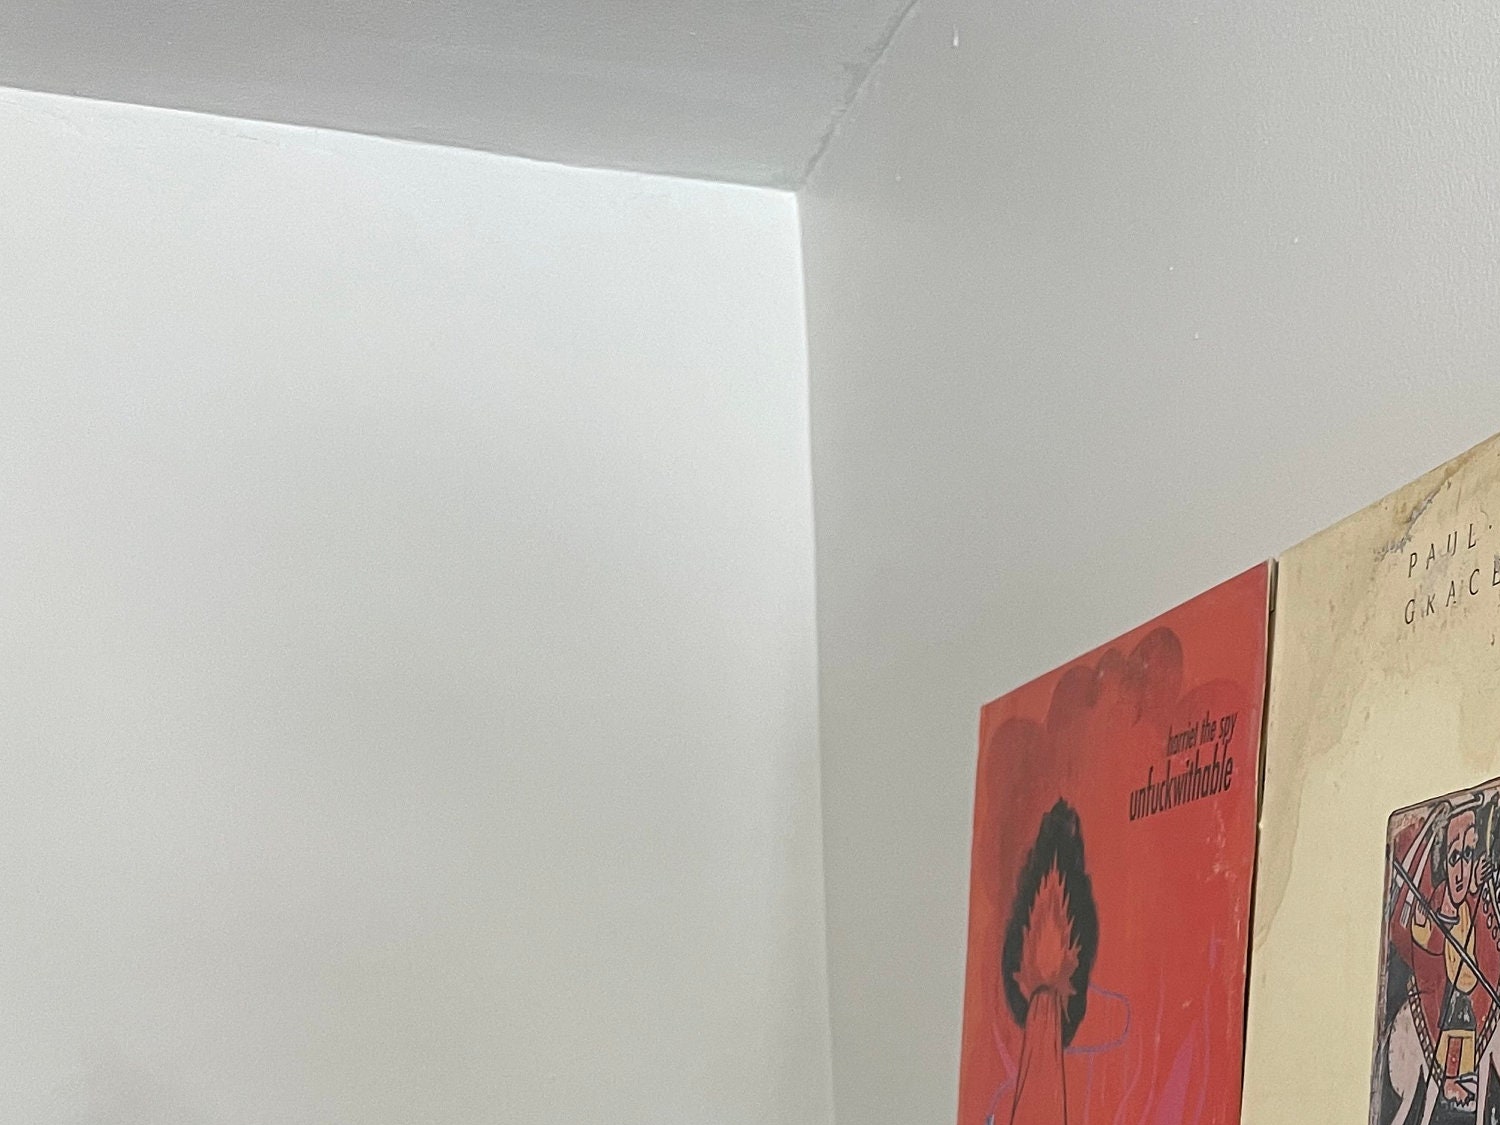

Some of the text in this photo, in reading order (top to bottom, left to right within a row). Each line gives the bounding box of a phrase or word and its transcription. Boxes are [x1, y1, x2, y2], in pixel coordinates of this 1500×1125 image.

[1408, 522, 1477, 578] PAUL
[1167, 710, 1239, 757] harriet the spy
[1129, 742, 1234, 822] unfuckwithable
